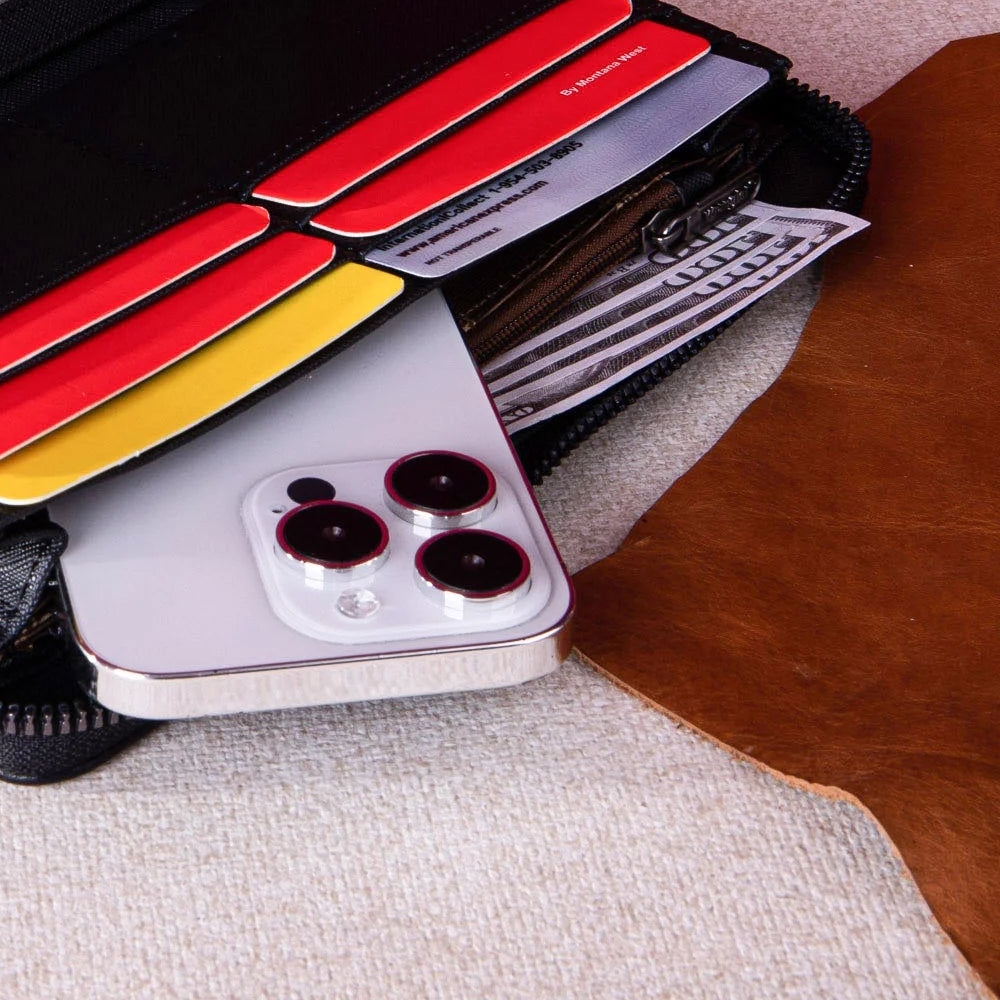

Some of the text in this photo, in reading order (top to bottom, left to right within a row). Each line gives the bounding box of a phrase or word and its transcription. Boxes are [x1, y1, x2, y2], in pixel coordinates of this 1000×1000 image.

[560, 45, 647, 96] By Montana West
